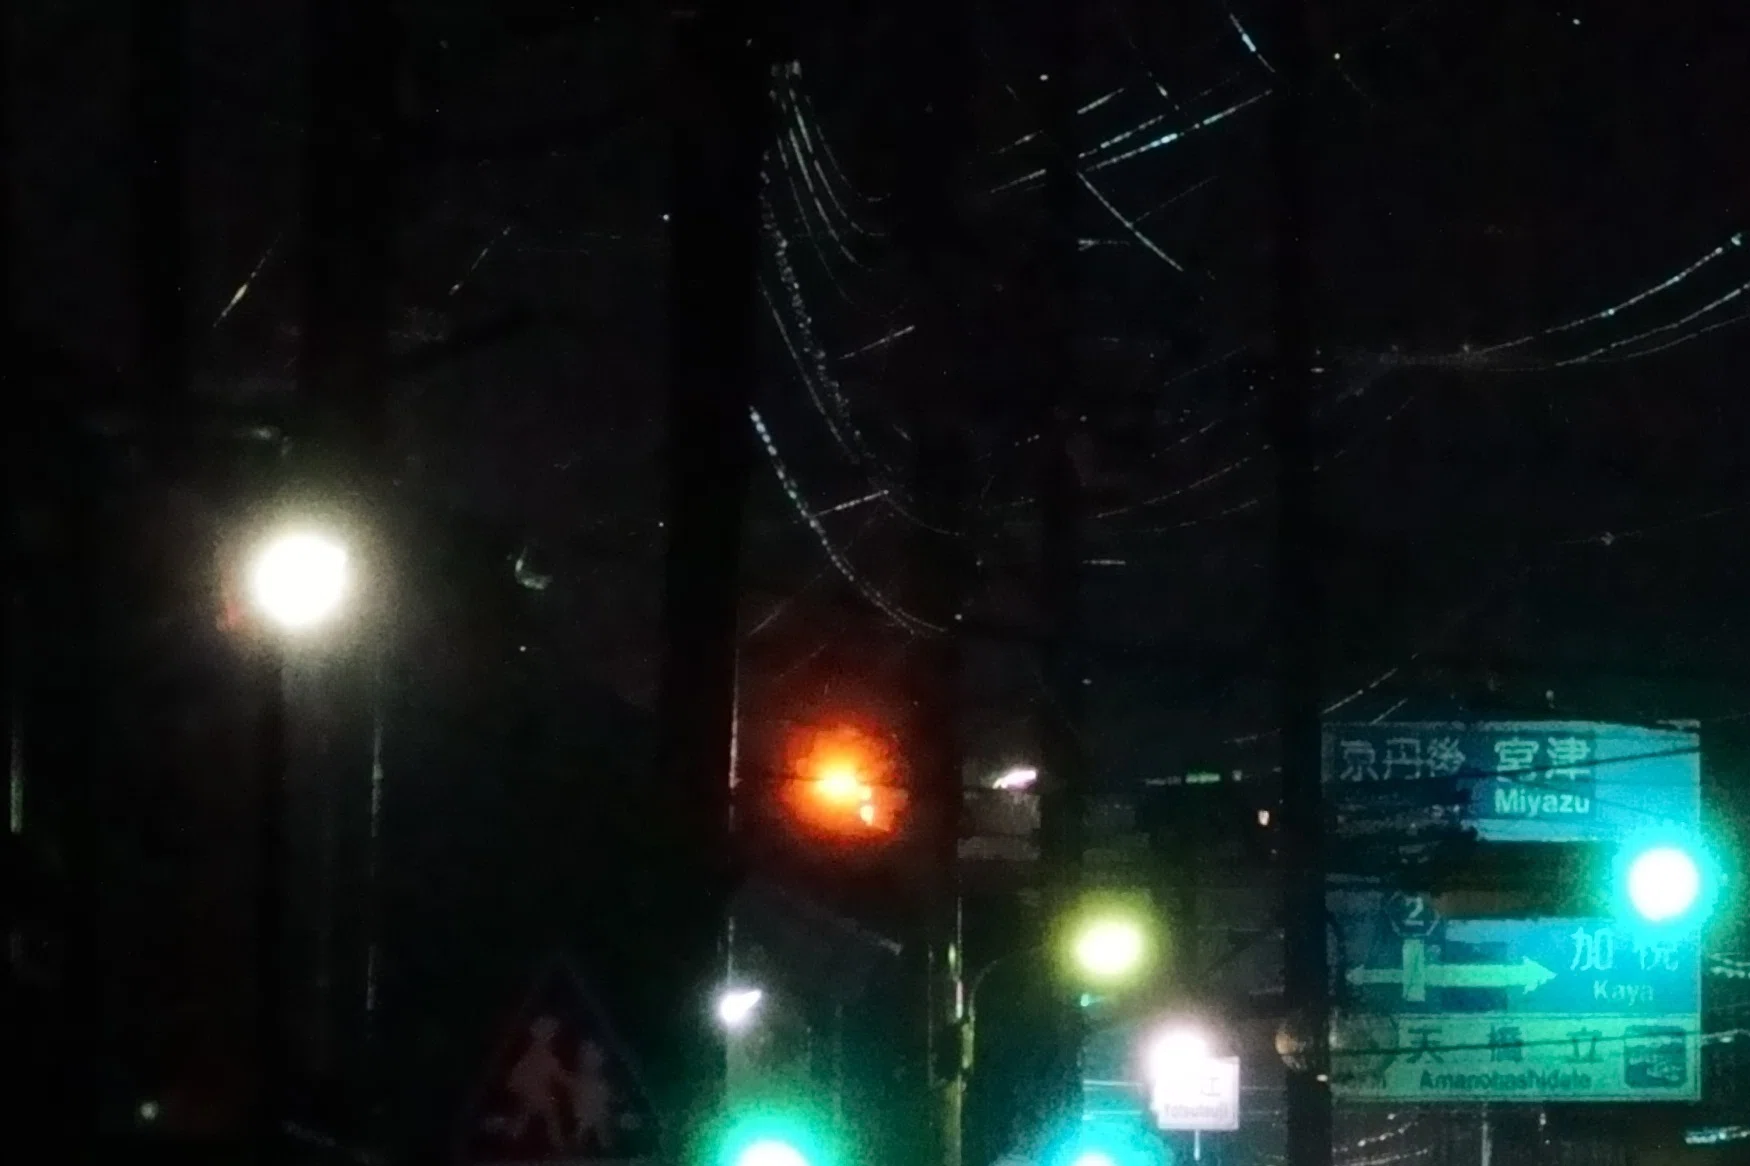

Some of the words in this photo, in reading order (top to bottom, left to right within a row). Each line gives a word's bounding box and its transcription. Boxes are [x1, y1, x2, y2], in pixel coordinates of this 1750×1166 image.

[1493, 737, 1591, 781] 宮津
[1494, 789, 1590, 817] Miyazu
[1594, 980, 1654, 1006] Kaya
